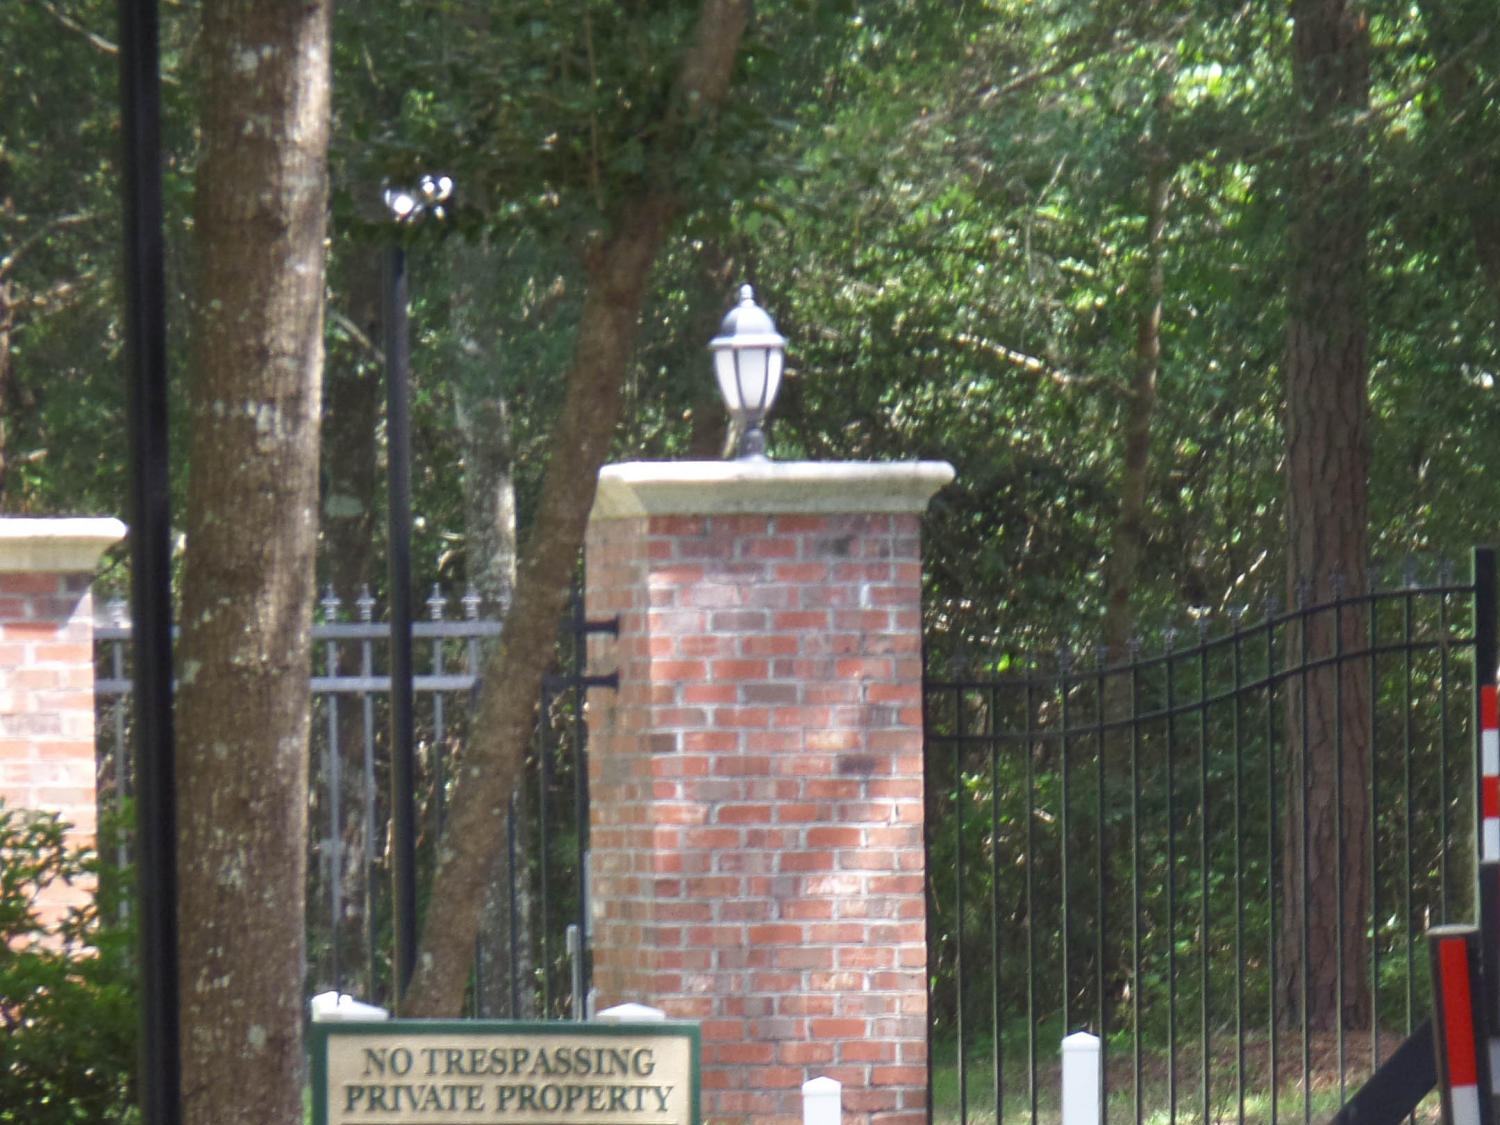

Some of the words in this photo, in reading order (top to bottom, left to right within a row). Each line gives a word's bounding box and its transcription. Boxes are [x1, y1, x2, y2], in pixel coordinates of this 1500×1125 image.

[363, 1047, 413, 1076] NO
[421, 1047, 656, 1076] TRESPASSING
[343, 1084, 485, 1113] PRIVATE
[495, 1084, 674, 1113] PROPERTY
